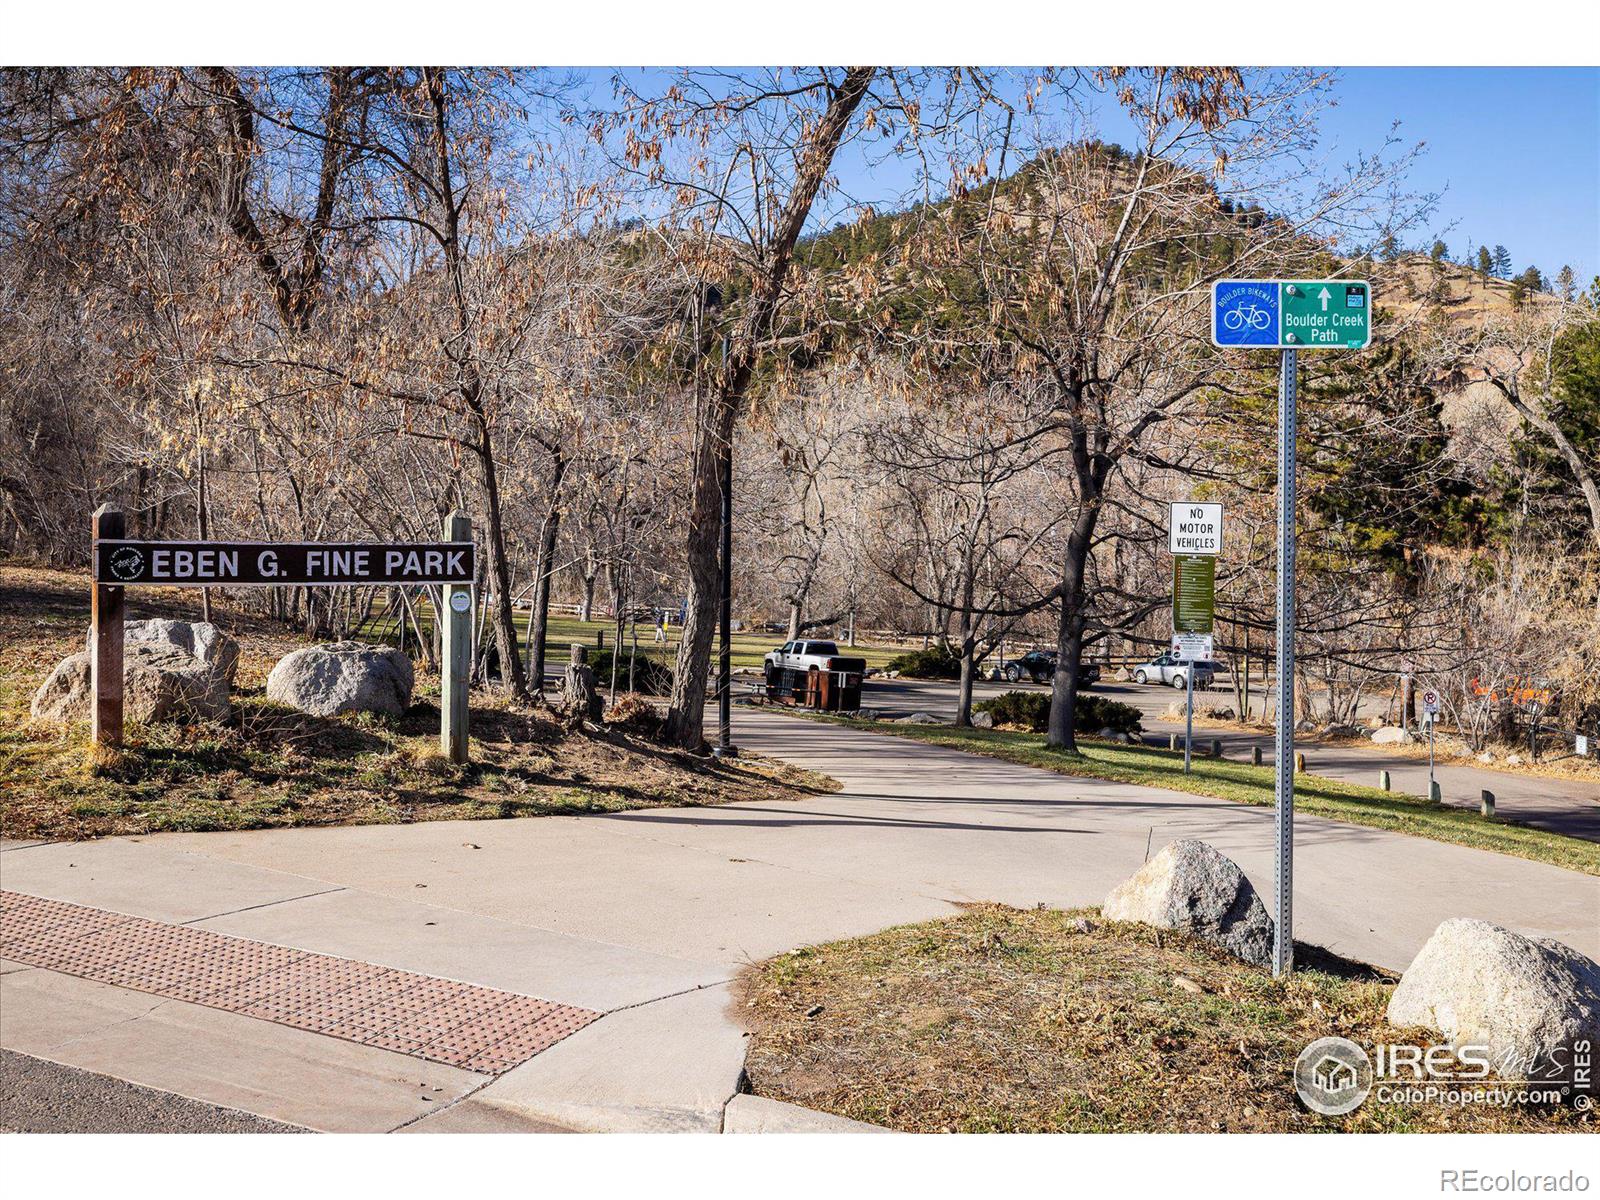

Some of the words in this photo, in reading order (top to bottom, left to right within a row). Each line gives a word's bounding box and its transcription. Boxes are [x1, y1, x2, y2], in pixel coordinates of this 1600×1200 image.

[1217, 287, 1246, 308] BOULDER
[1247, 287, 1278, 309] BIKEWAYS
[1285, 312, 1328, 327] Boulder
[1332, 312, 1364, 327] Creek
[1311, 328, 1338, 342] Path
[1190, 508, 1204, 520] NO
[1179, 522, 1214, 534] MOTOR
[1176, 537, 1215, 549] VEHICLES
[152, 550, 239, 577] EBEN
[257, 550, 288, 577] G.
[306, 550, 370, 576] FINE
[385, 550, 466, 576] PARK
